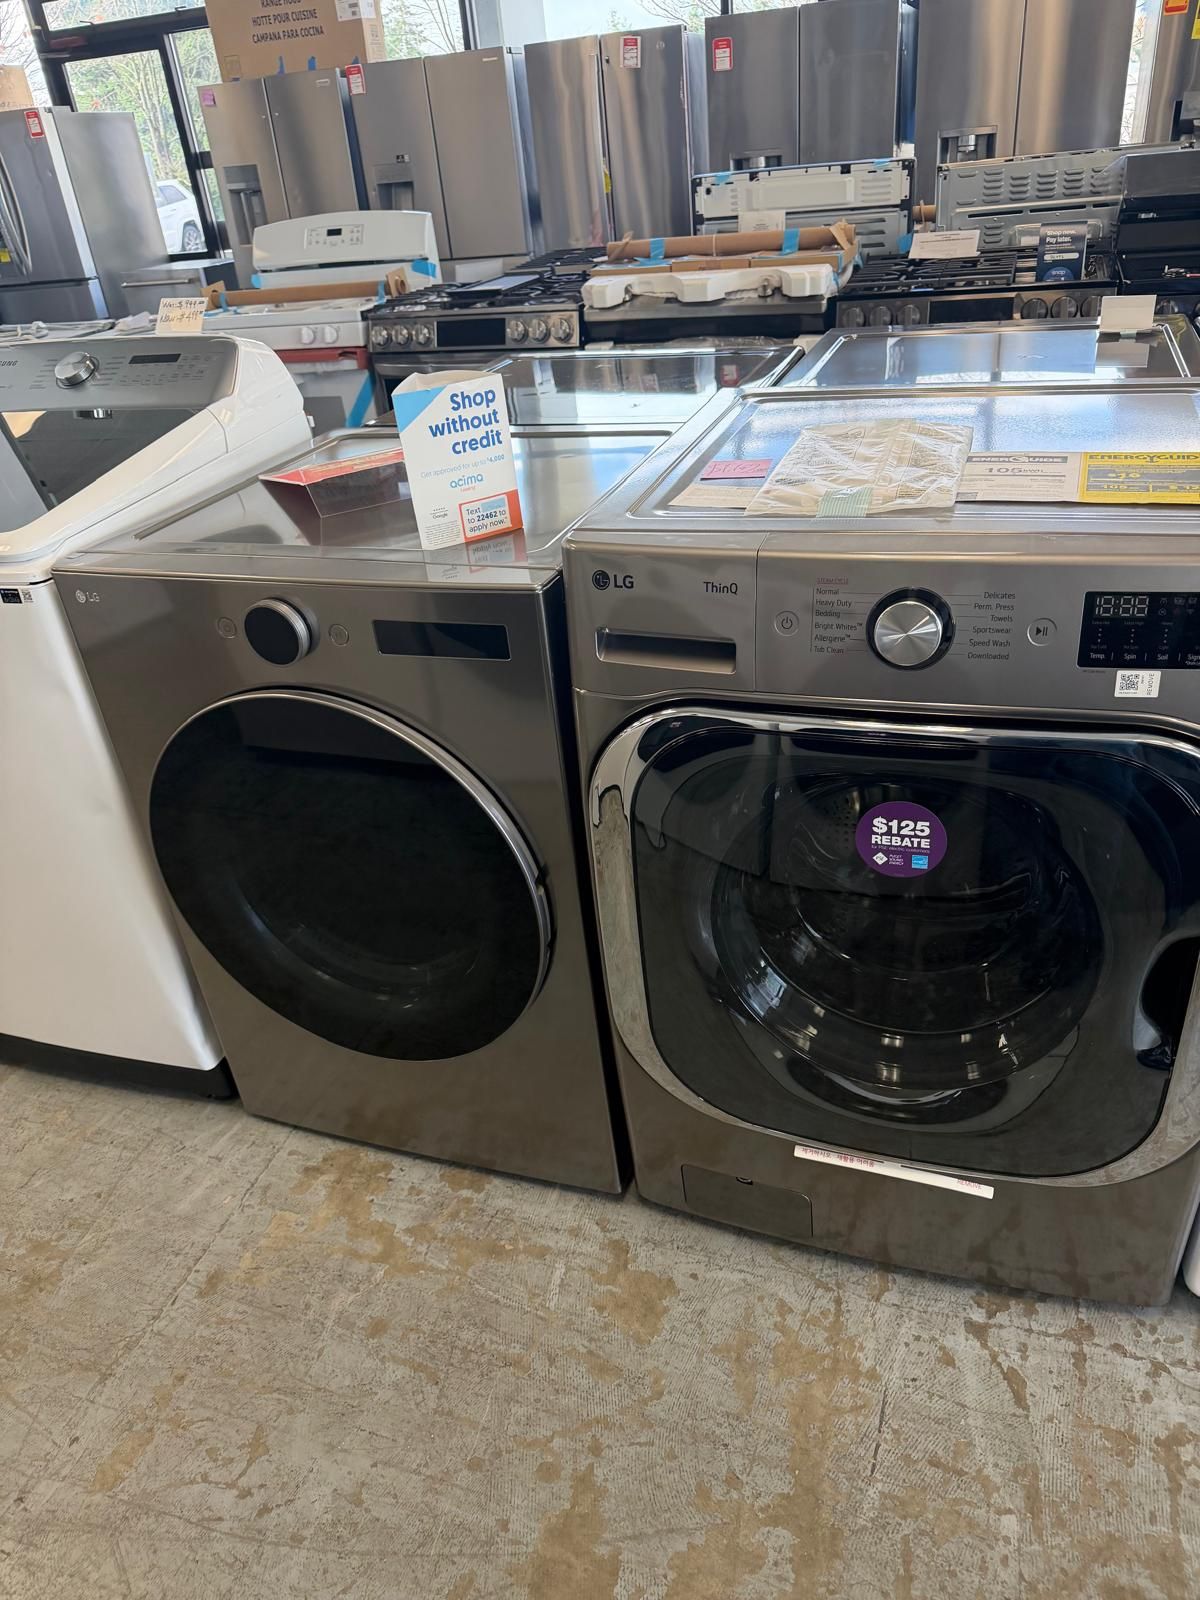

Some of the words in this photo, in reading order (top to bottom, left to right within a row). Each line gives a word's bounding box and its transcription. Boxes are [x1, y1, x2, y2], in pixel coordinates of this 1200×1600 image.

[252, 15, 272, 27] HOTTE
[273, 12, 291, 24] POUR
[291, 9, 318, 22] CUISINE
[252, 32, 282, 44] CAMPANA
[282, 28, 300, 40] PARA
[300, 25, 325, 38] COCINA
[450, 389, 496, 412] Shop
[428, 409, 500, 438] without
[451, 429, 503, 455] credit
[1089, 454, 1200, 463] ENERGYGUID
[420, 471, 432, 479] Get
[432, 465, 461, 478] approved
[486, 454, 505, 463] $4,000
[449, 473, 484, 489] acima
[466, 507, 481, 516] Text
[467, 517, 476, 525] to
[476, 510, 499, 523] 22462
[499, 509, 507, 517] to
[469, 522, 488, 533] apply
[613, 574, 634, 589] LG
[703, 581, 738, 595] ThinQ
[86, 591, 100, 602] LG
[983, 591, 1016, 600] Delicates
[815, 599, 836, 608] Heavy
[836, 600, 852, 608] Duty
[974, 602, 993, 611] Perm.
[995, 602, 1015, 611] Press
[815, 609, 841, 618] Bedding
[991, 614, 1014, 622] Towels
[814, 622, 835, 631] Bright
[972, 625, 1012, 635] Sportswear
[968, 638, 991, 648] Speed
[991, 639, 1011, 648] Wash
[814, 645, 826, 653] Tub
[826, 646, 844, 654] Clean
[967, 652, 1010, 661] Downloaded
[1124, 653, 1137, 661] Spin
[1157, 653, 1169, 661] Soil
[871, 816, 931, 837] $125
[871, 834, 931, 849] REBATE
